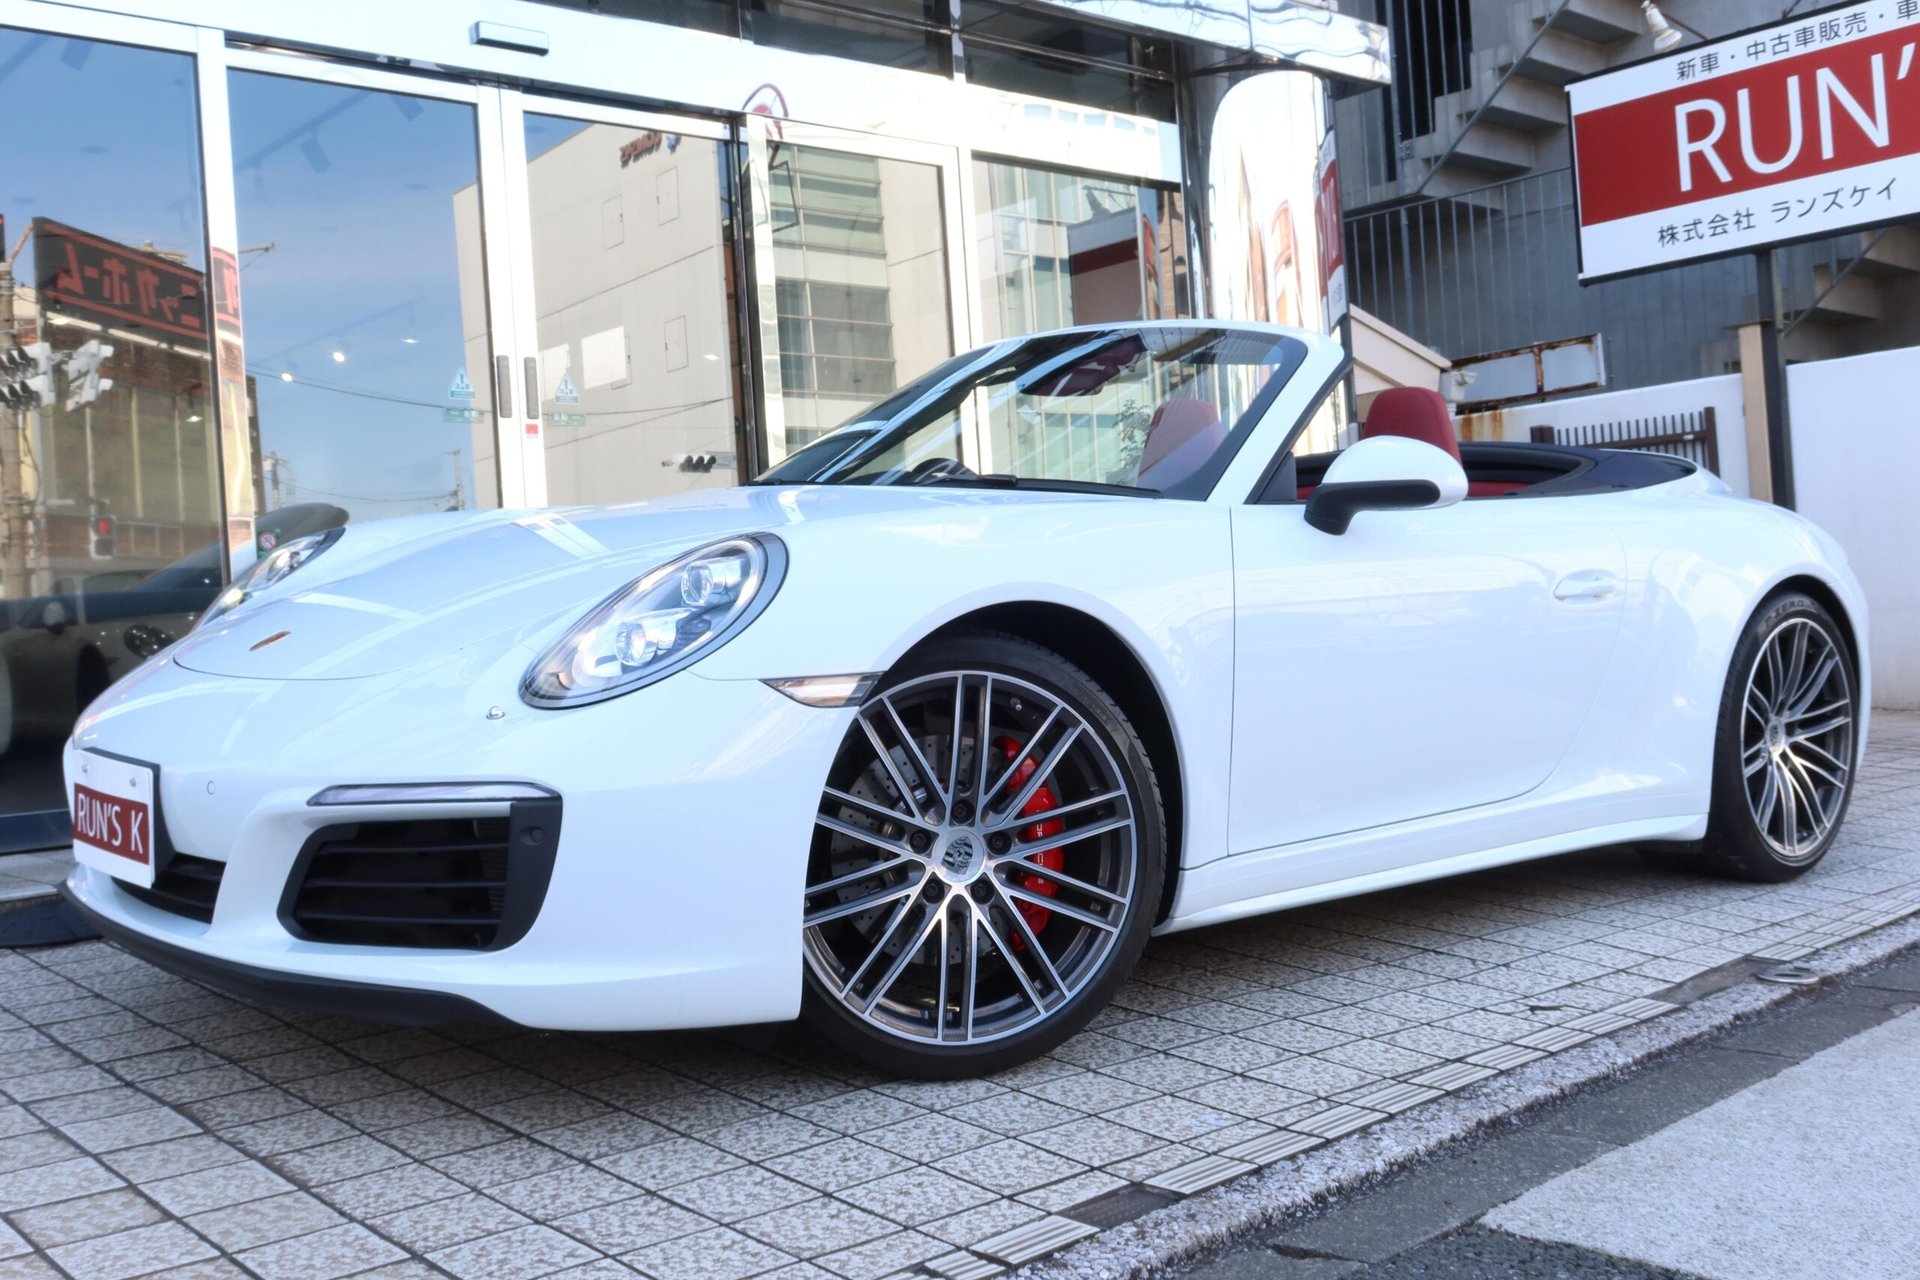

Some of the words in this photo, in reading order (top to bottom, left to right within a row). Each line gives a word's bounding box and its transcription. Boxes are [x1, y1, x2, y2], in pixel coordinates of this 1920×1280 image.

[1676, 0, 1920, 81] 新車・中古車販売・車
[1674, 42, 1917, 192] RUN'
[1657, 208, 1756, 248] 株式会社
[1770, 177, 1897, 224] ランズケイ
[78, 793, 122, 846] RUN'S
[131, 810, 143, 854] K
